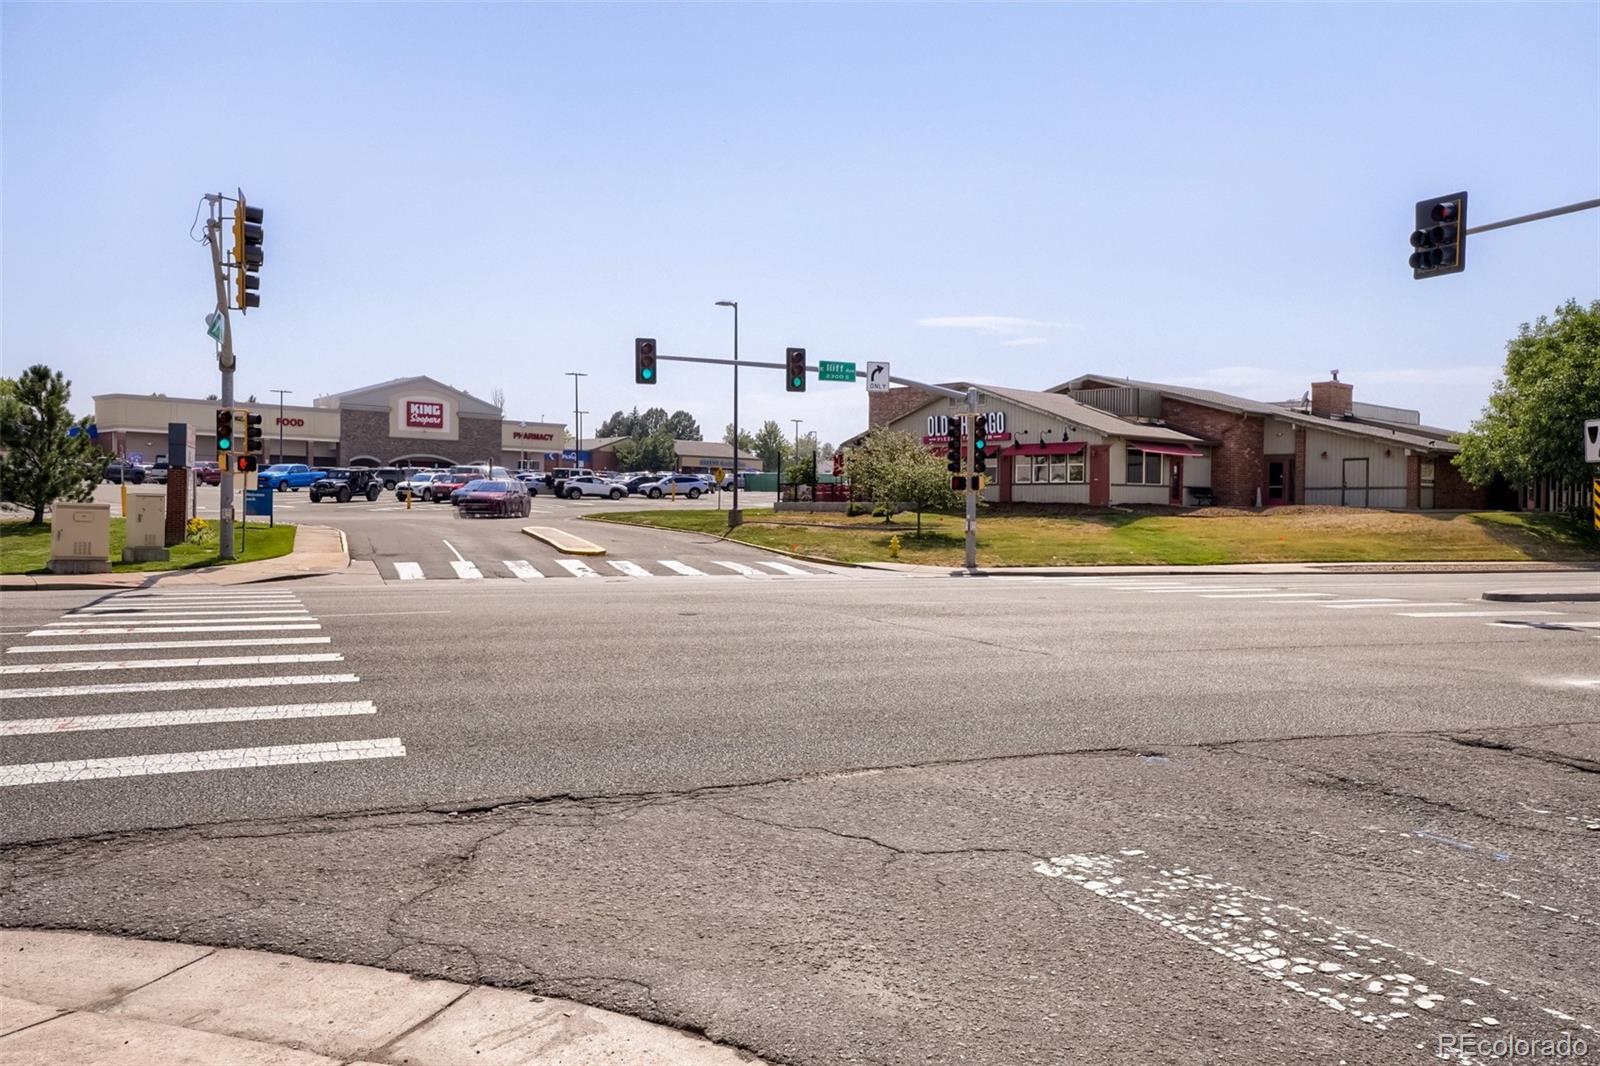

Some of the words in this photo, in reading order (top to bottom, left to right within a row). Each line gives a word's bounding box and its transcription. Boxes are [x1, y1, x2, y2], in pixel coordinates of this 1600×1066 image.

[826, 363, 844, 373] Iliff
[410, 404, 441, 416] KING
[276, 417, 304, 427] FOOD
[409, 413, 442, 426] Soopers
[927, 415, 948, 437] OLD
[512, 431, 554, 442] PHARMACY
